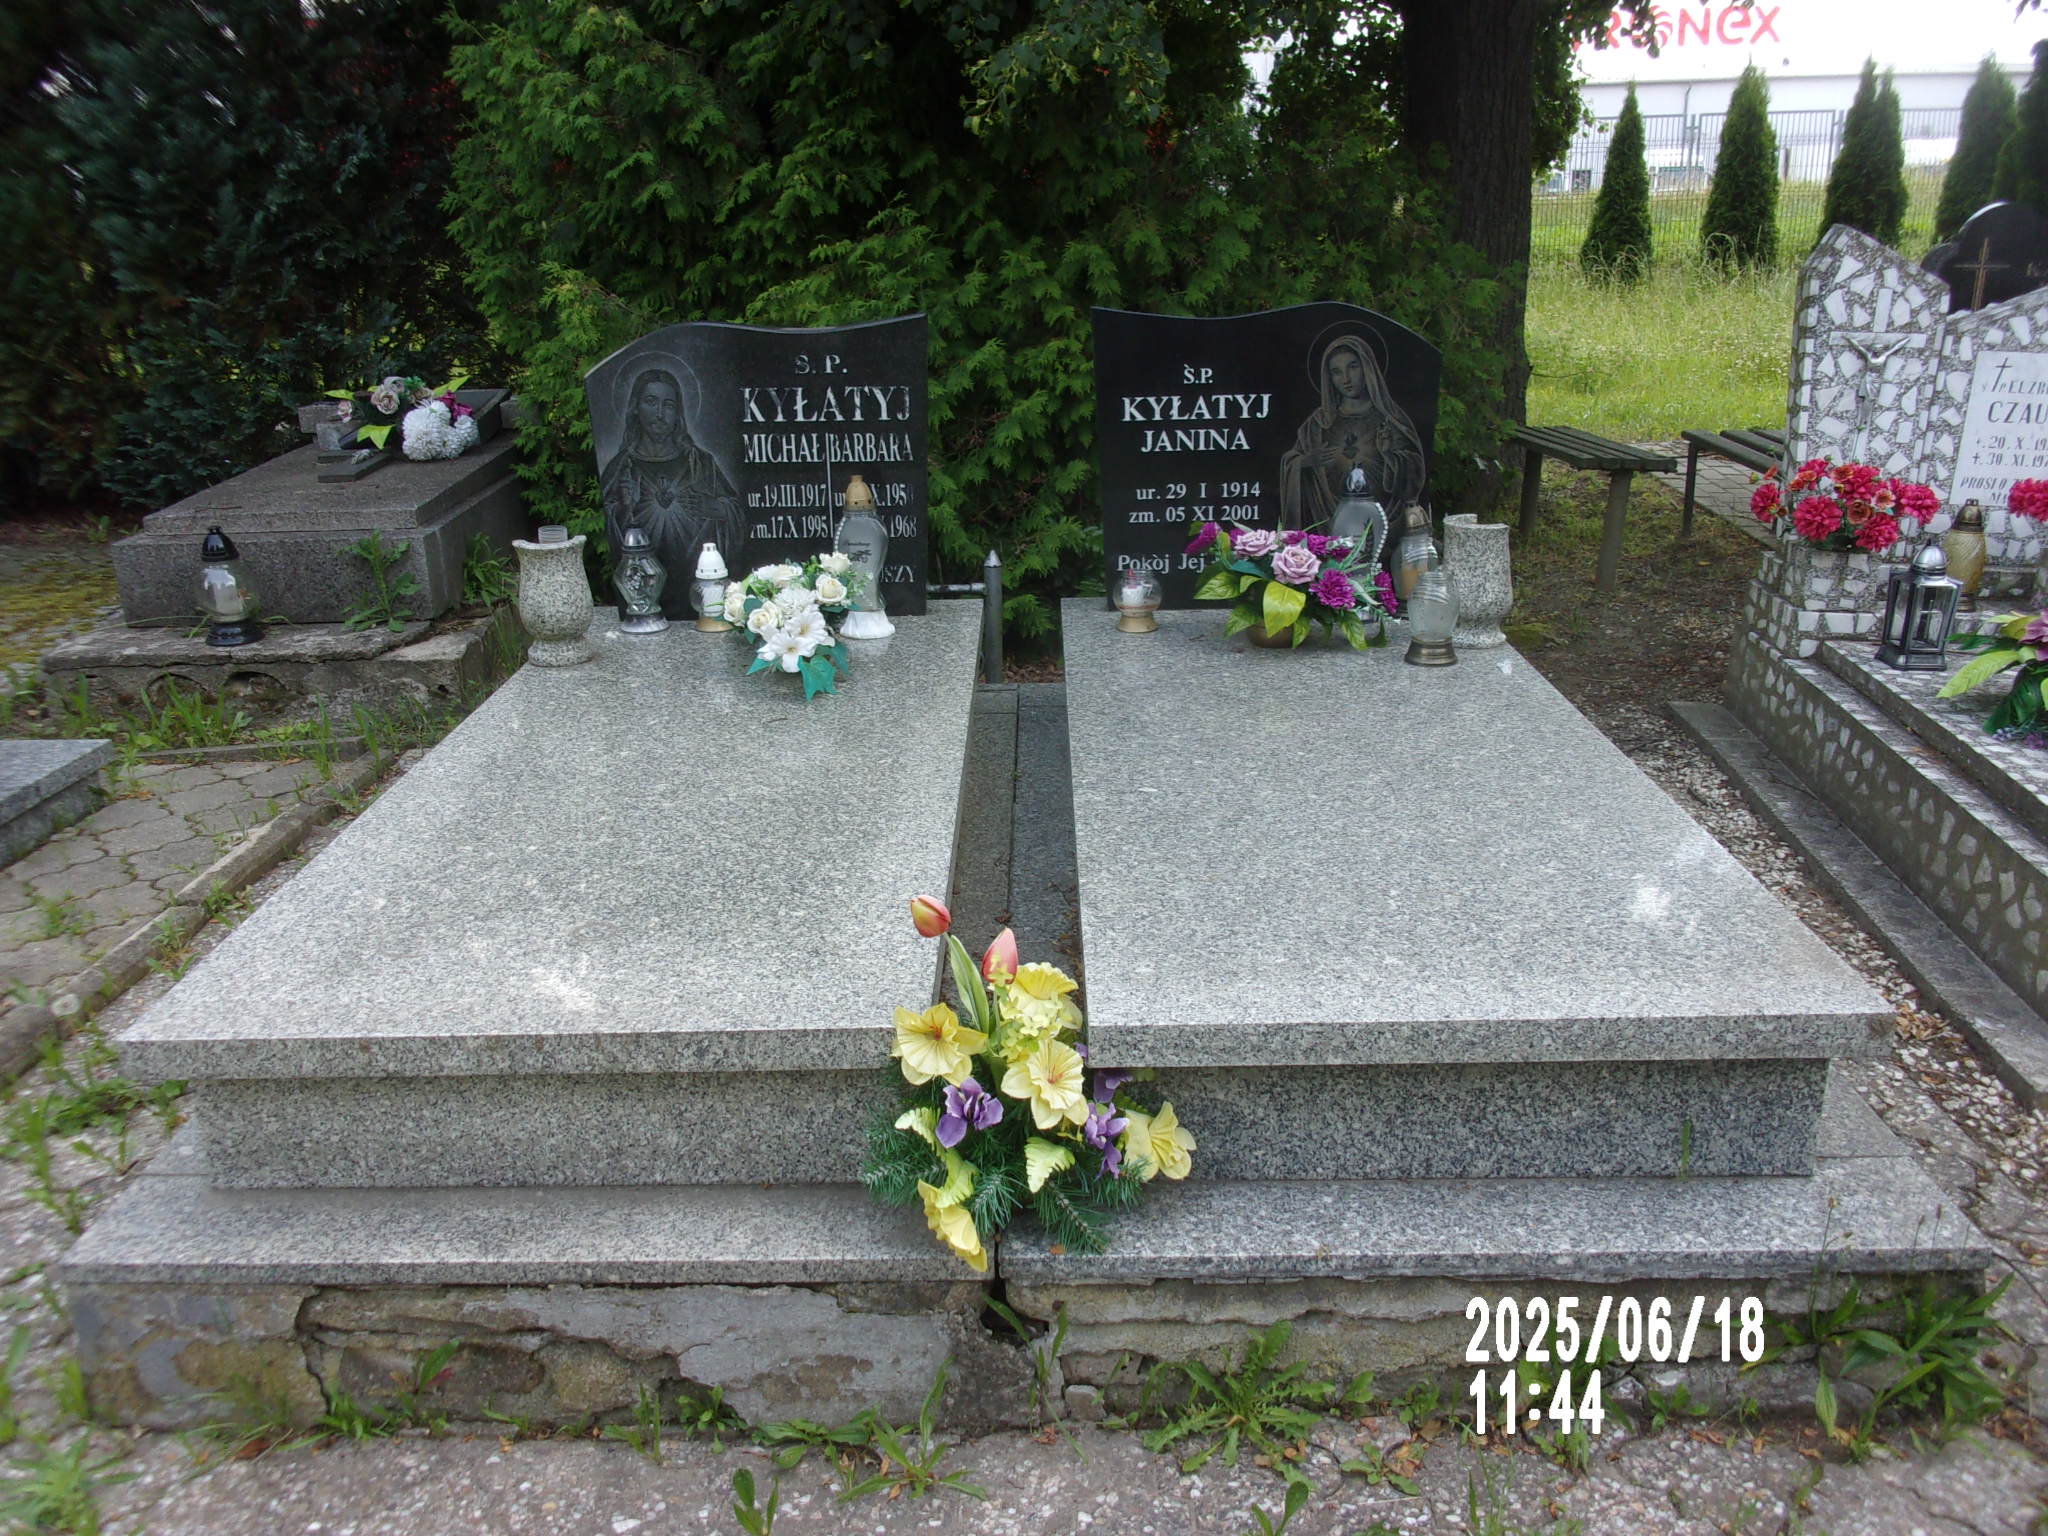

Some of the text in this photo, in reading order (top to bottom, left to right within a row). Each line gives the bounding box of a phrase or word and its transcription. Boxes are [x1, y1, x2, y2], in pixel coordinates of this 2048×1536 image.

[740, 386, 911, 422] KYŁATYJ
[1121, 393, 1272, 422] KYŁATYJ
[743, 432, 914, 463] MICHAŁ BARBARA
[1141, 428, 1251, 452] JANINA
[1136, 482, 1261, 500] ur. 29 I 1914
[1128, 504, 1260, 523] zm. 05 XI 2001
[801, 514, 829, 539] 1995
[1178, 552, 1206, 573] Jej
